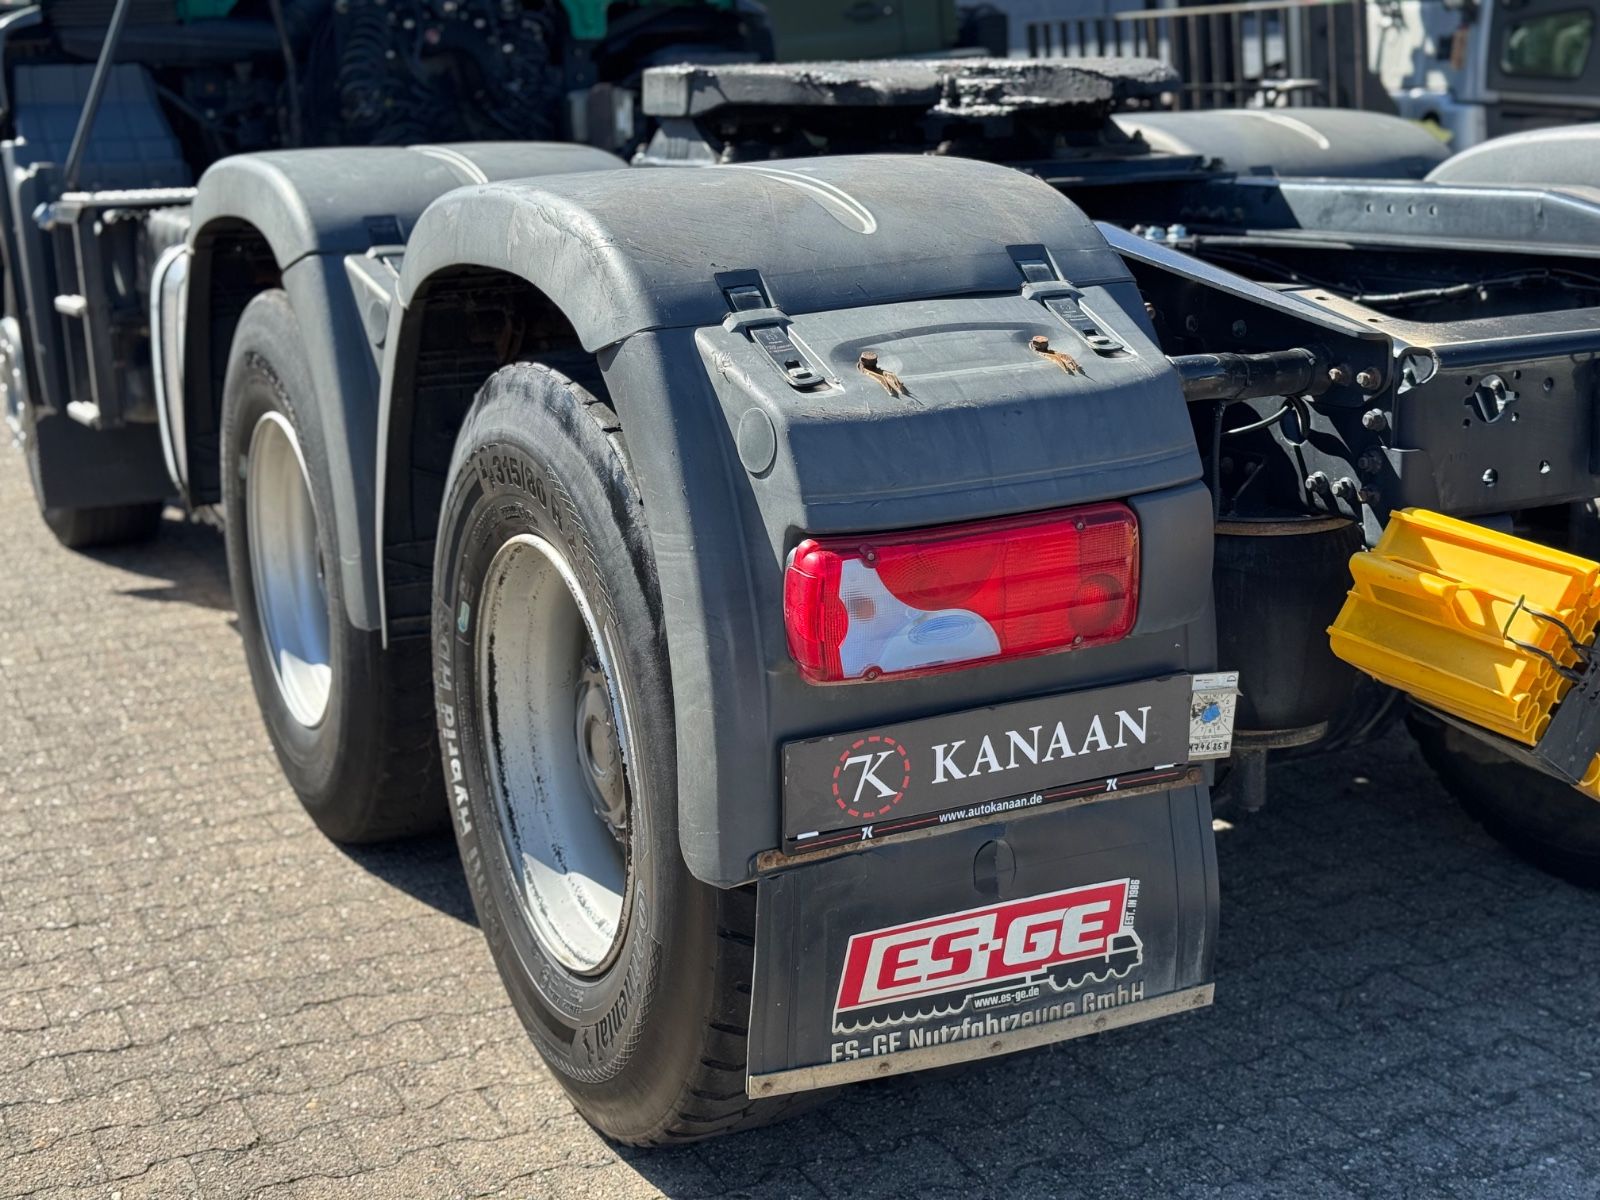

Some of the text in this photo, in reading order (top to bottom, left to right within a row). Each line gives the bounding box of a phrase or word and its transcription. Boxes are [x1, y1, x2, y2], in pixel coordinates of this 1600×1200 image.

[931, 705, 1152, 785] KANAAN
[441, 704, 472, 837] Hybrid
[938, 793, 1043, 823] www.autokanaan.de
[1124, 879, 1141, 926] EST. IN 1986
[875, 899, 1112, 991] ES-GE
[974, 986, 1040, 1009] www.es-ge.de
[1082, 982, 1144, 1013] GmbH
